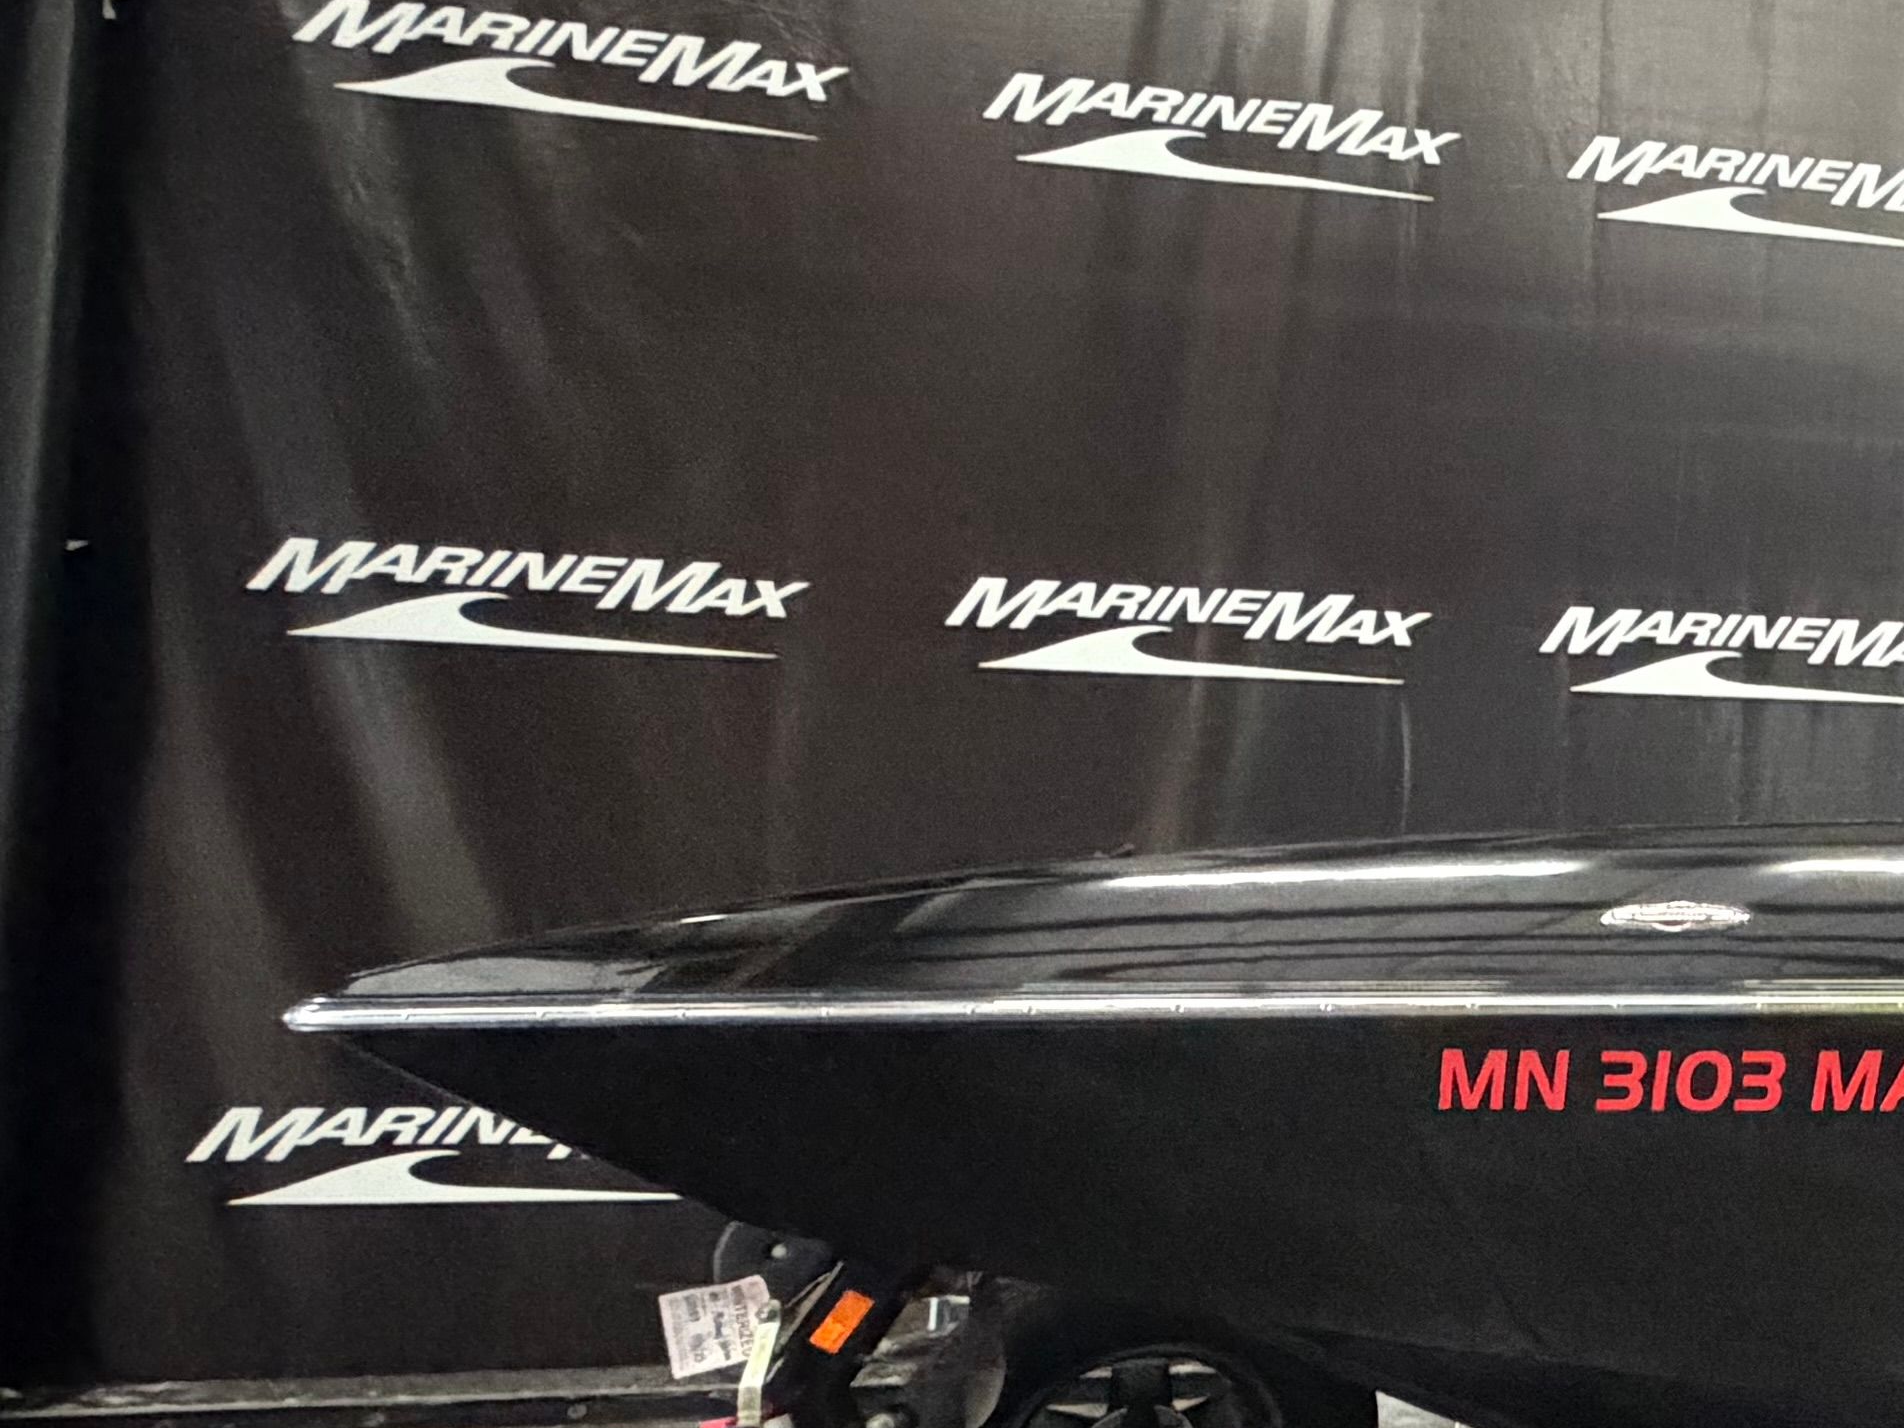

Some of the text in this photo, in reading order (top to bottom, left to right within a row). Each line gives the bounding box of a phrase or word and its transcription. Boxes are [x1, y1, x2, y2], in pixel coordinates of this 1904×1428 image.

[983, 72, 1461, 167] MARINEMAX
[246, 535, 811, 622] MARINEMAX
[944, 576, 1432, 648] MARINEMAX
[1437, 1047, 1571, 1112] MN
[1595, 1049, 1788, 1113] 3103
[184, 1106, 591, 1163] MARIN
